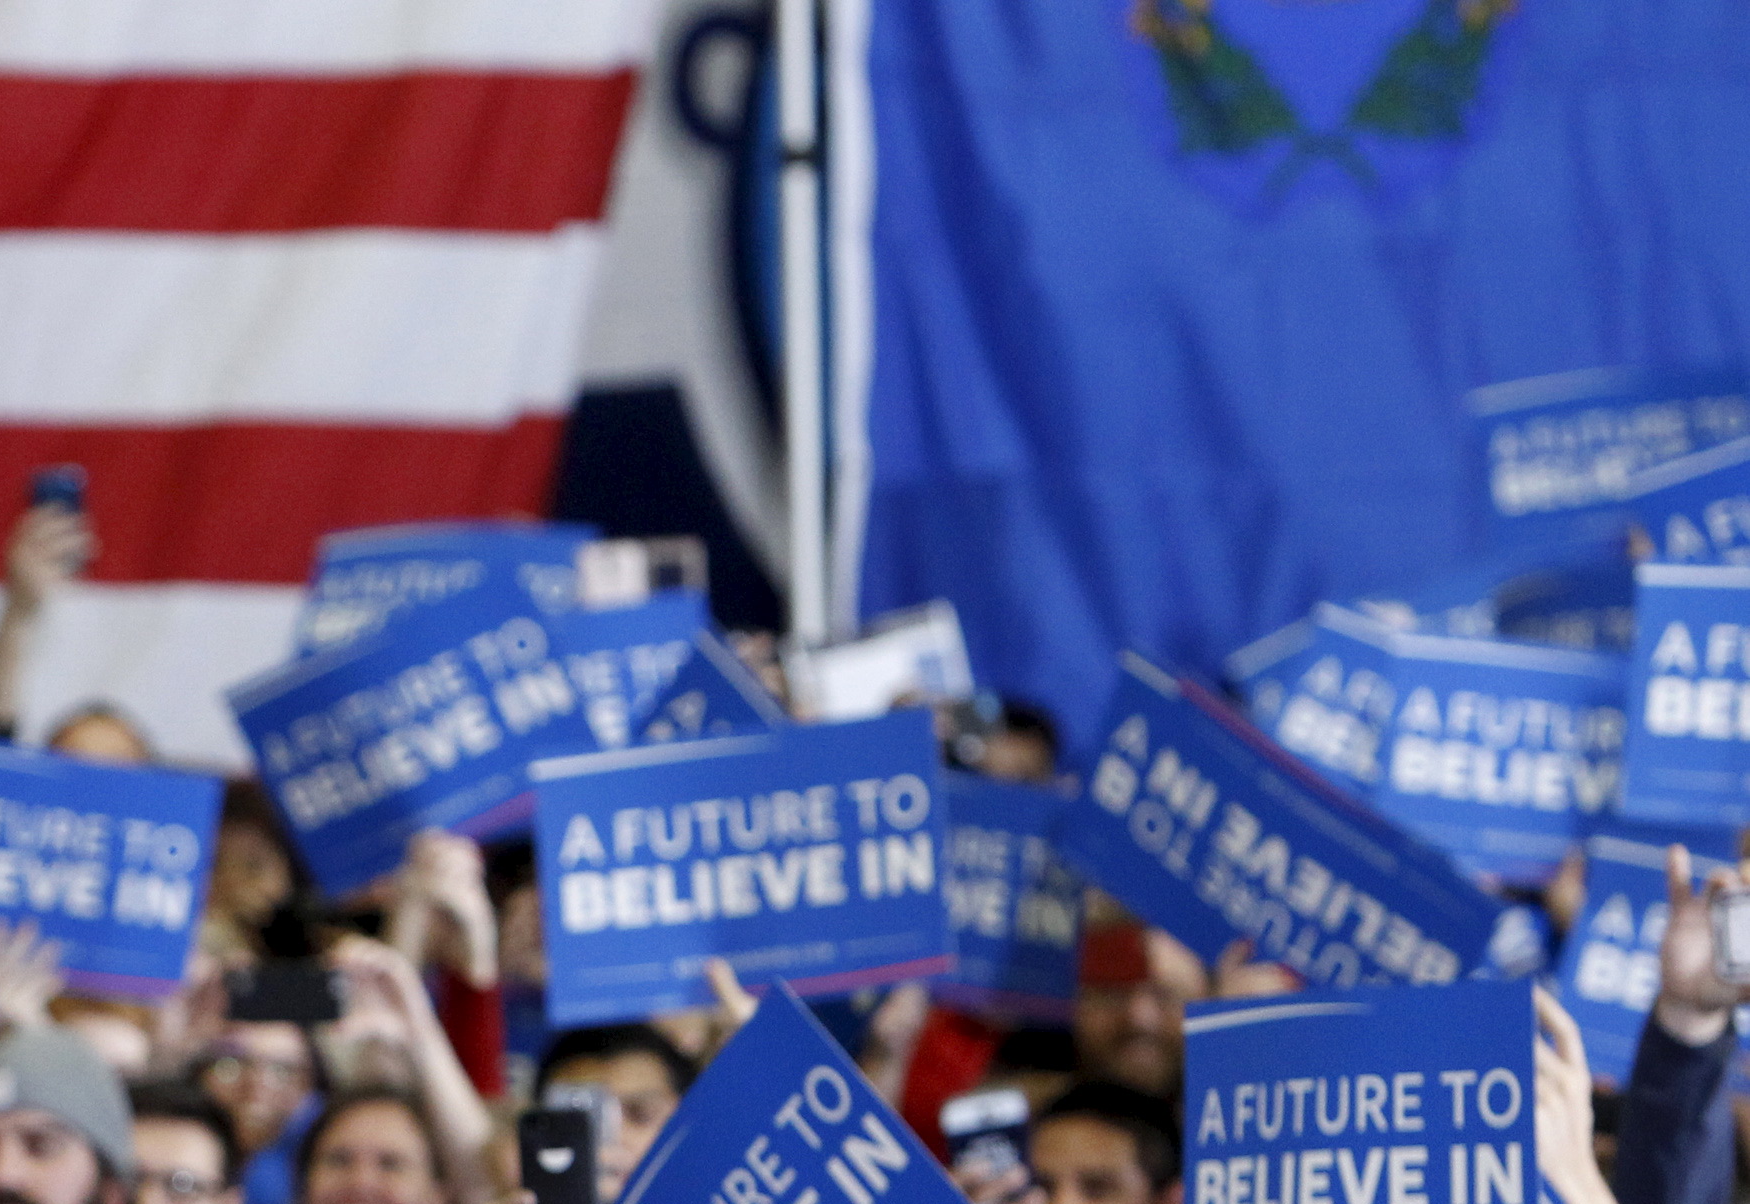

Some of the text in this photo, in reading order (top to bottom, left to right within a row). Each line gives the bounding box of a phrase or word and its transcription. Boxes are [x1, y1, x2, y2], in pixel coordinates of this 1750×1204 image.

[1653, 621, 1698, 678] A
[1397, 685, 1442, 736] A
[1389, 732, 1628, 814] BELIEV
[559, 773, 931, 869] A FUTURE TO
[559, 842, 850, 936] BELIEVE
[857, 832, 938, 900] IN
[774, 1063, 853, 1153] TO
[1197, 1066, 1523, 1146] A FUTURE TO
